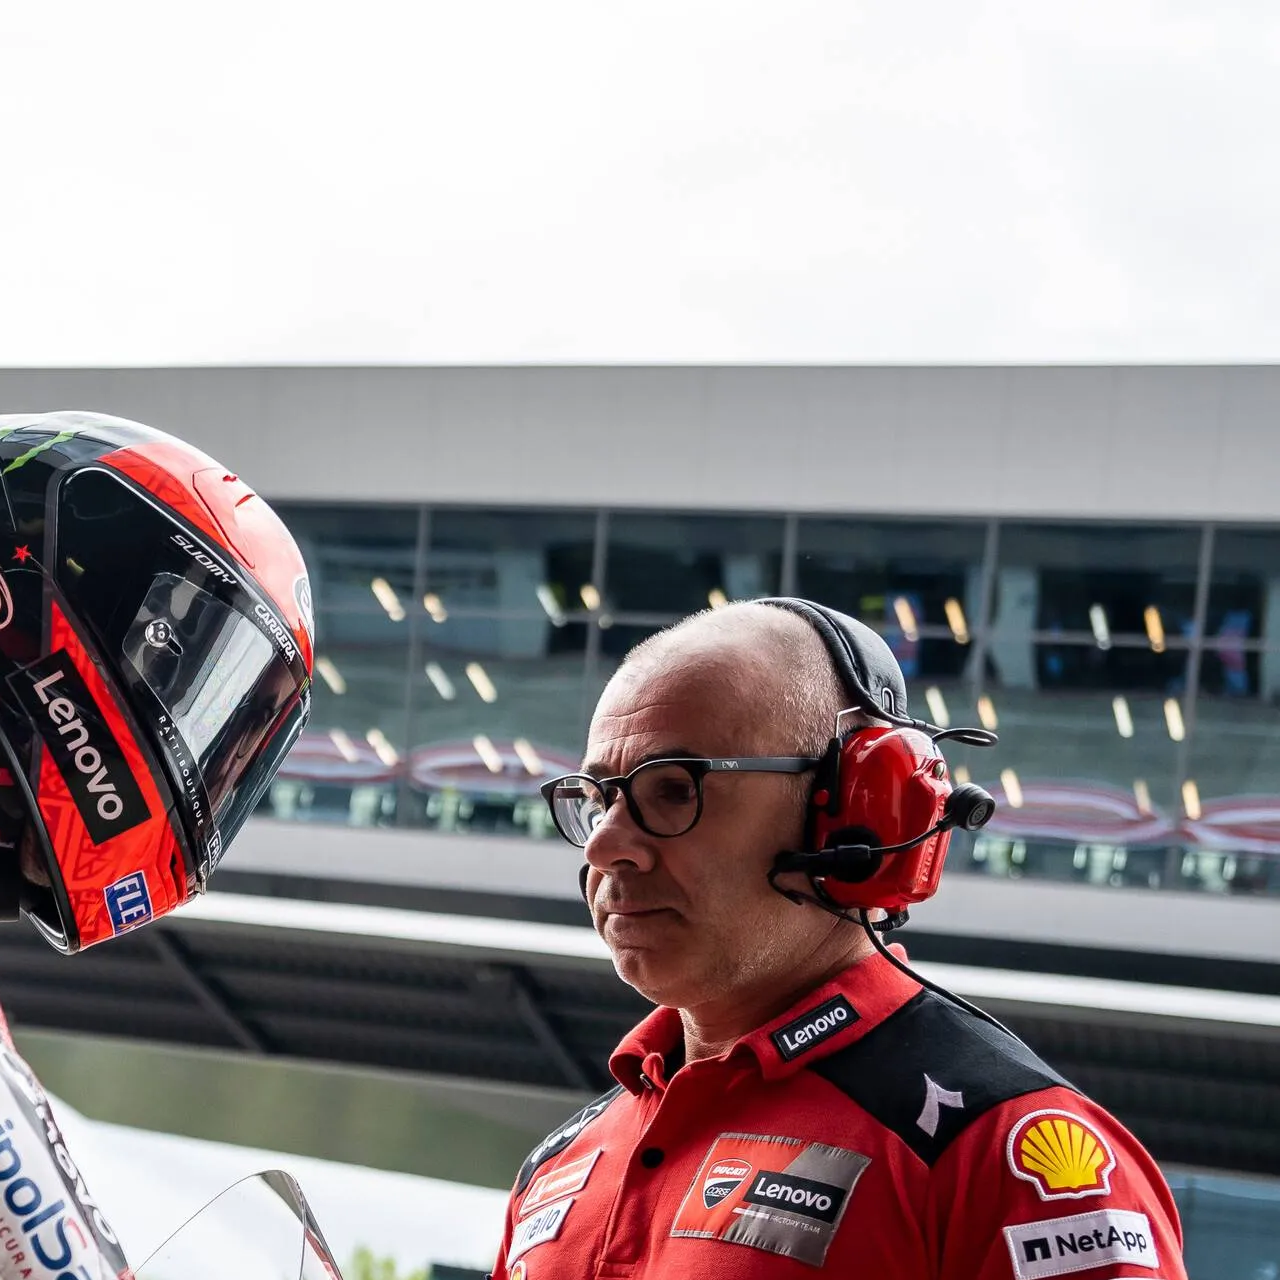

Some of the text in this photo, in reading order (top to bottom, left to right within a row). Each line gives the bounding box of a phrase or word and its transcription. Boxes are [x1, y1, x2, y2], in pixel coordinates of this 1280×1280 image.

[169, 534, 238, 586] SUOMY
[254, 604, 297, 663] CARRERA
[33, 670, 124, 821] Lenovo
[782, 1006, 848, 1051] Lenovo
[712, 1165, 749, 1176] DUCATI
[705, 1186, 732, 1197] CORSE
[754, 1177, 832, 1211] Lenovo
[800, 1221, 821, 1235] TEAM
[1055, 1225, 1148, 1257] NetApp
